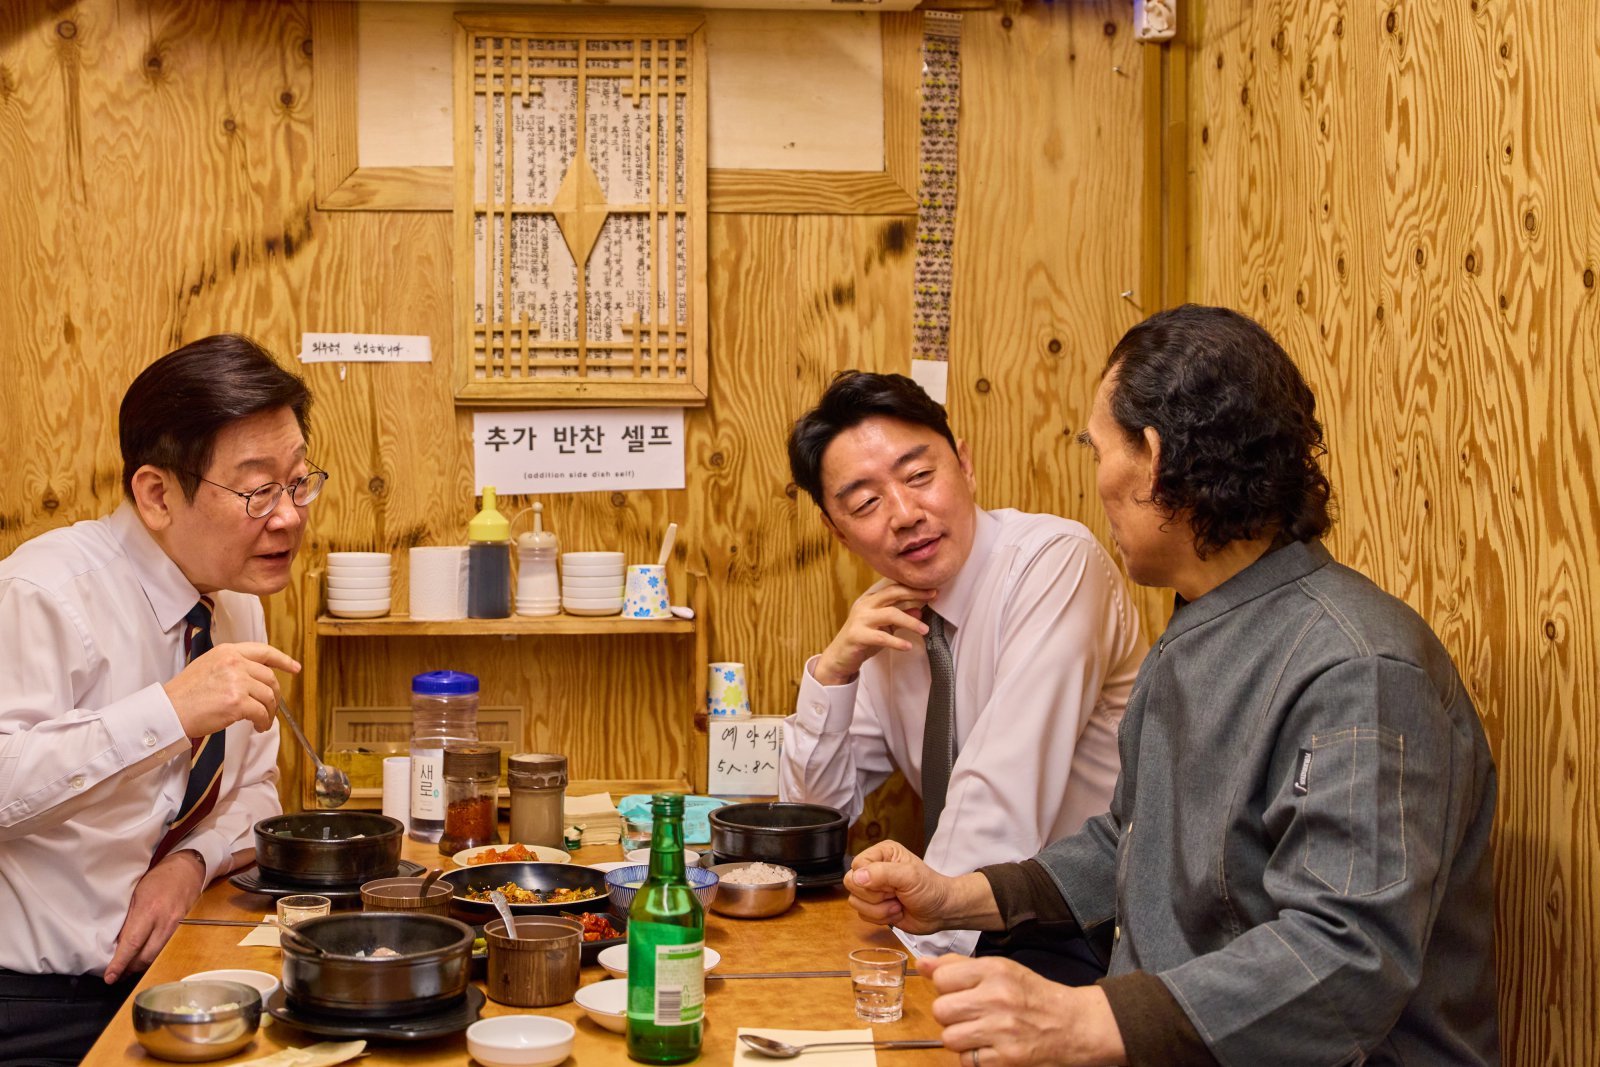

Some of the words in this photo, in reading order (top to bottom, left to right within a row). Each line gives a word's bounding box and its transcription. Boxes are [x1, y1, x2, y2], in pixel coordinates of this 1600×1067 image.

[485, 426, 537, 452] 추가
[554, 425, 605, 454] 반찬
[621, 425, 672, 453] 셀프
[524, 471, 565, 480] (addition
[569, 471, 588, 479] side
[592, 470, 611, 478] dish
[420, 764, 433, 796] 새로
